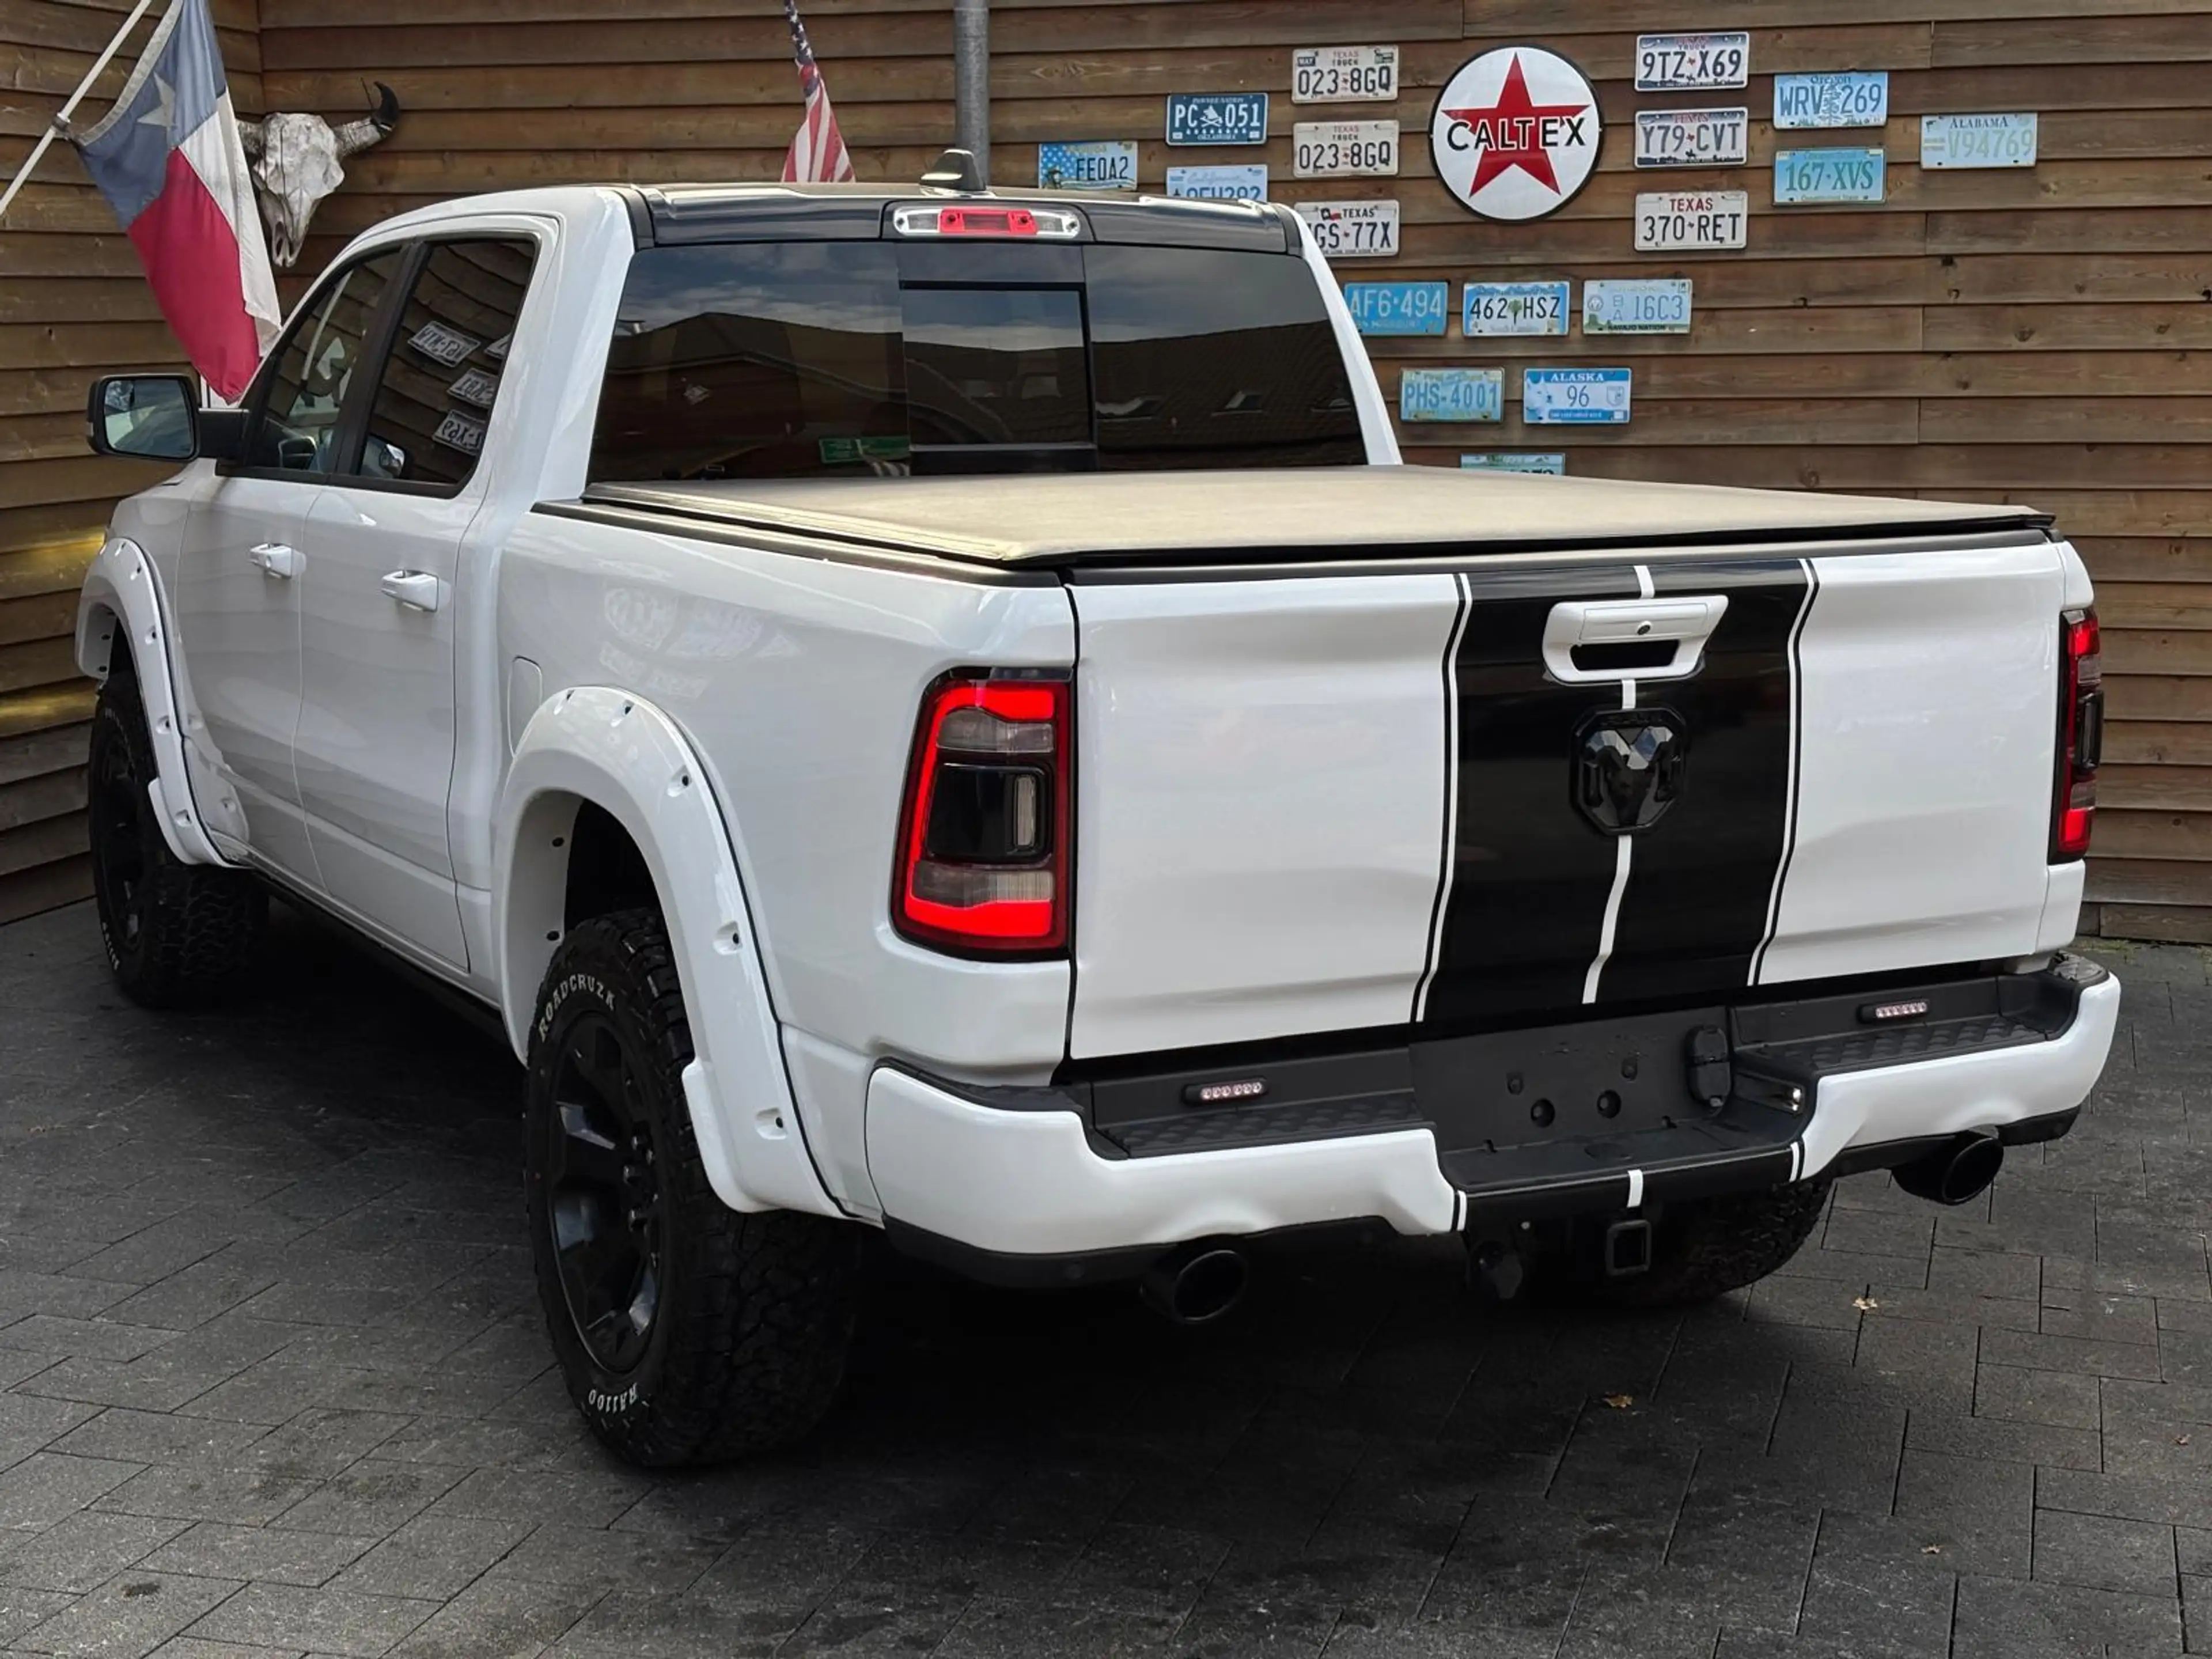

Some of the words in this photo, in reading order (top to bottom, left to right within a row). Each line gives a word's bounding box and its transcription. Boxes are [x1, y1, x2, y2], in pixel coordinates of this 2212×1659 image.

[1642, 51, 1687, 79] 9TZ
[1696, 48, 1742, 78] X69
[1298, 69, 1339, 95] 023
[1350, 66, 1391, 93] 8GQ
[1810, 75, 1851, 85] Oregon
[1779, 85, 1824, 116] WRV
[1840, 84, 1882, 114] 269
[1175, 104, 1199, 128] PC
[1225, 103, 1261, 127] 051
[1949, 116, 2009, 129] ALABAMA
[1446, 117, 1586, 151] CALTEX
[1642, 125, 1685, 154] Y79
[1696, 123, 1741, 151] CVT
[1299, 143, 1339, 169] 023
[1350, 141, 1391, 168] 8GQ
[1342, 208, 1375, 218] TEXAS
[1669, 198, 1713, 212] TEXAS
[1308, 222, 1340, 249] GS
[1351, 221, 1392, 248] 77X
[1643, 215, 1685, 242] 370
[1697, 213, 1741, 241] RET
[1469, 297, 1508, 320] 462
[1523, 297, 1561, 319] HSZ
[1551, 373, 1605, 381] ALASKA
[1567, 385, 1590, 407] 96
